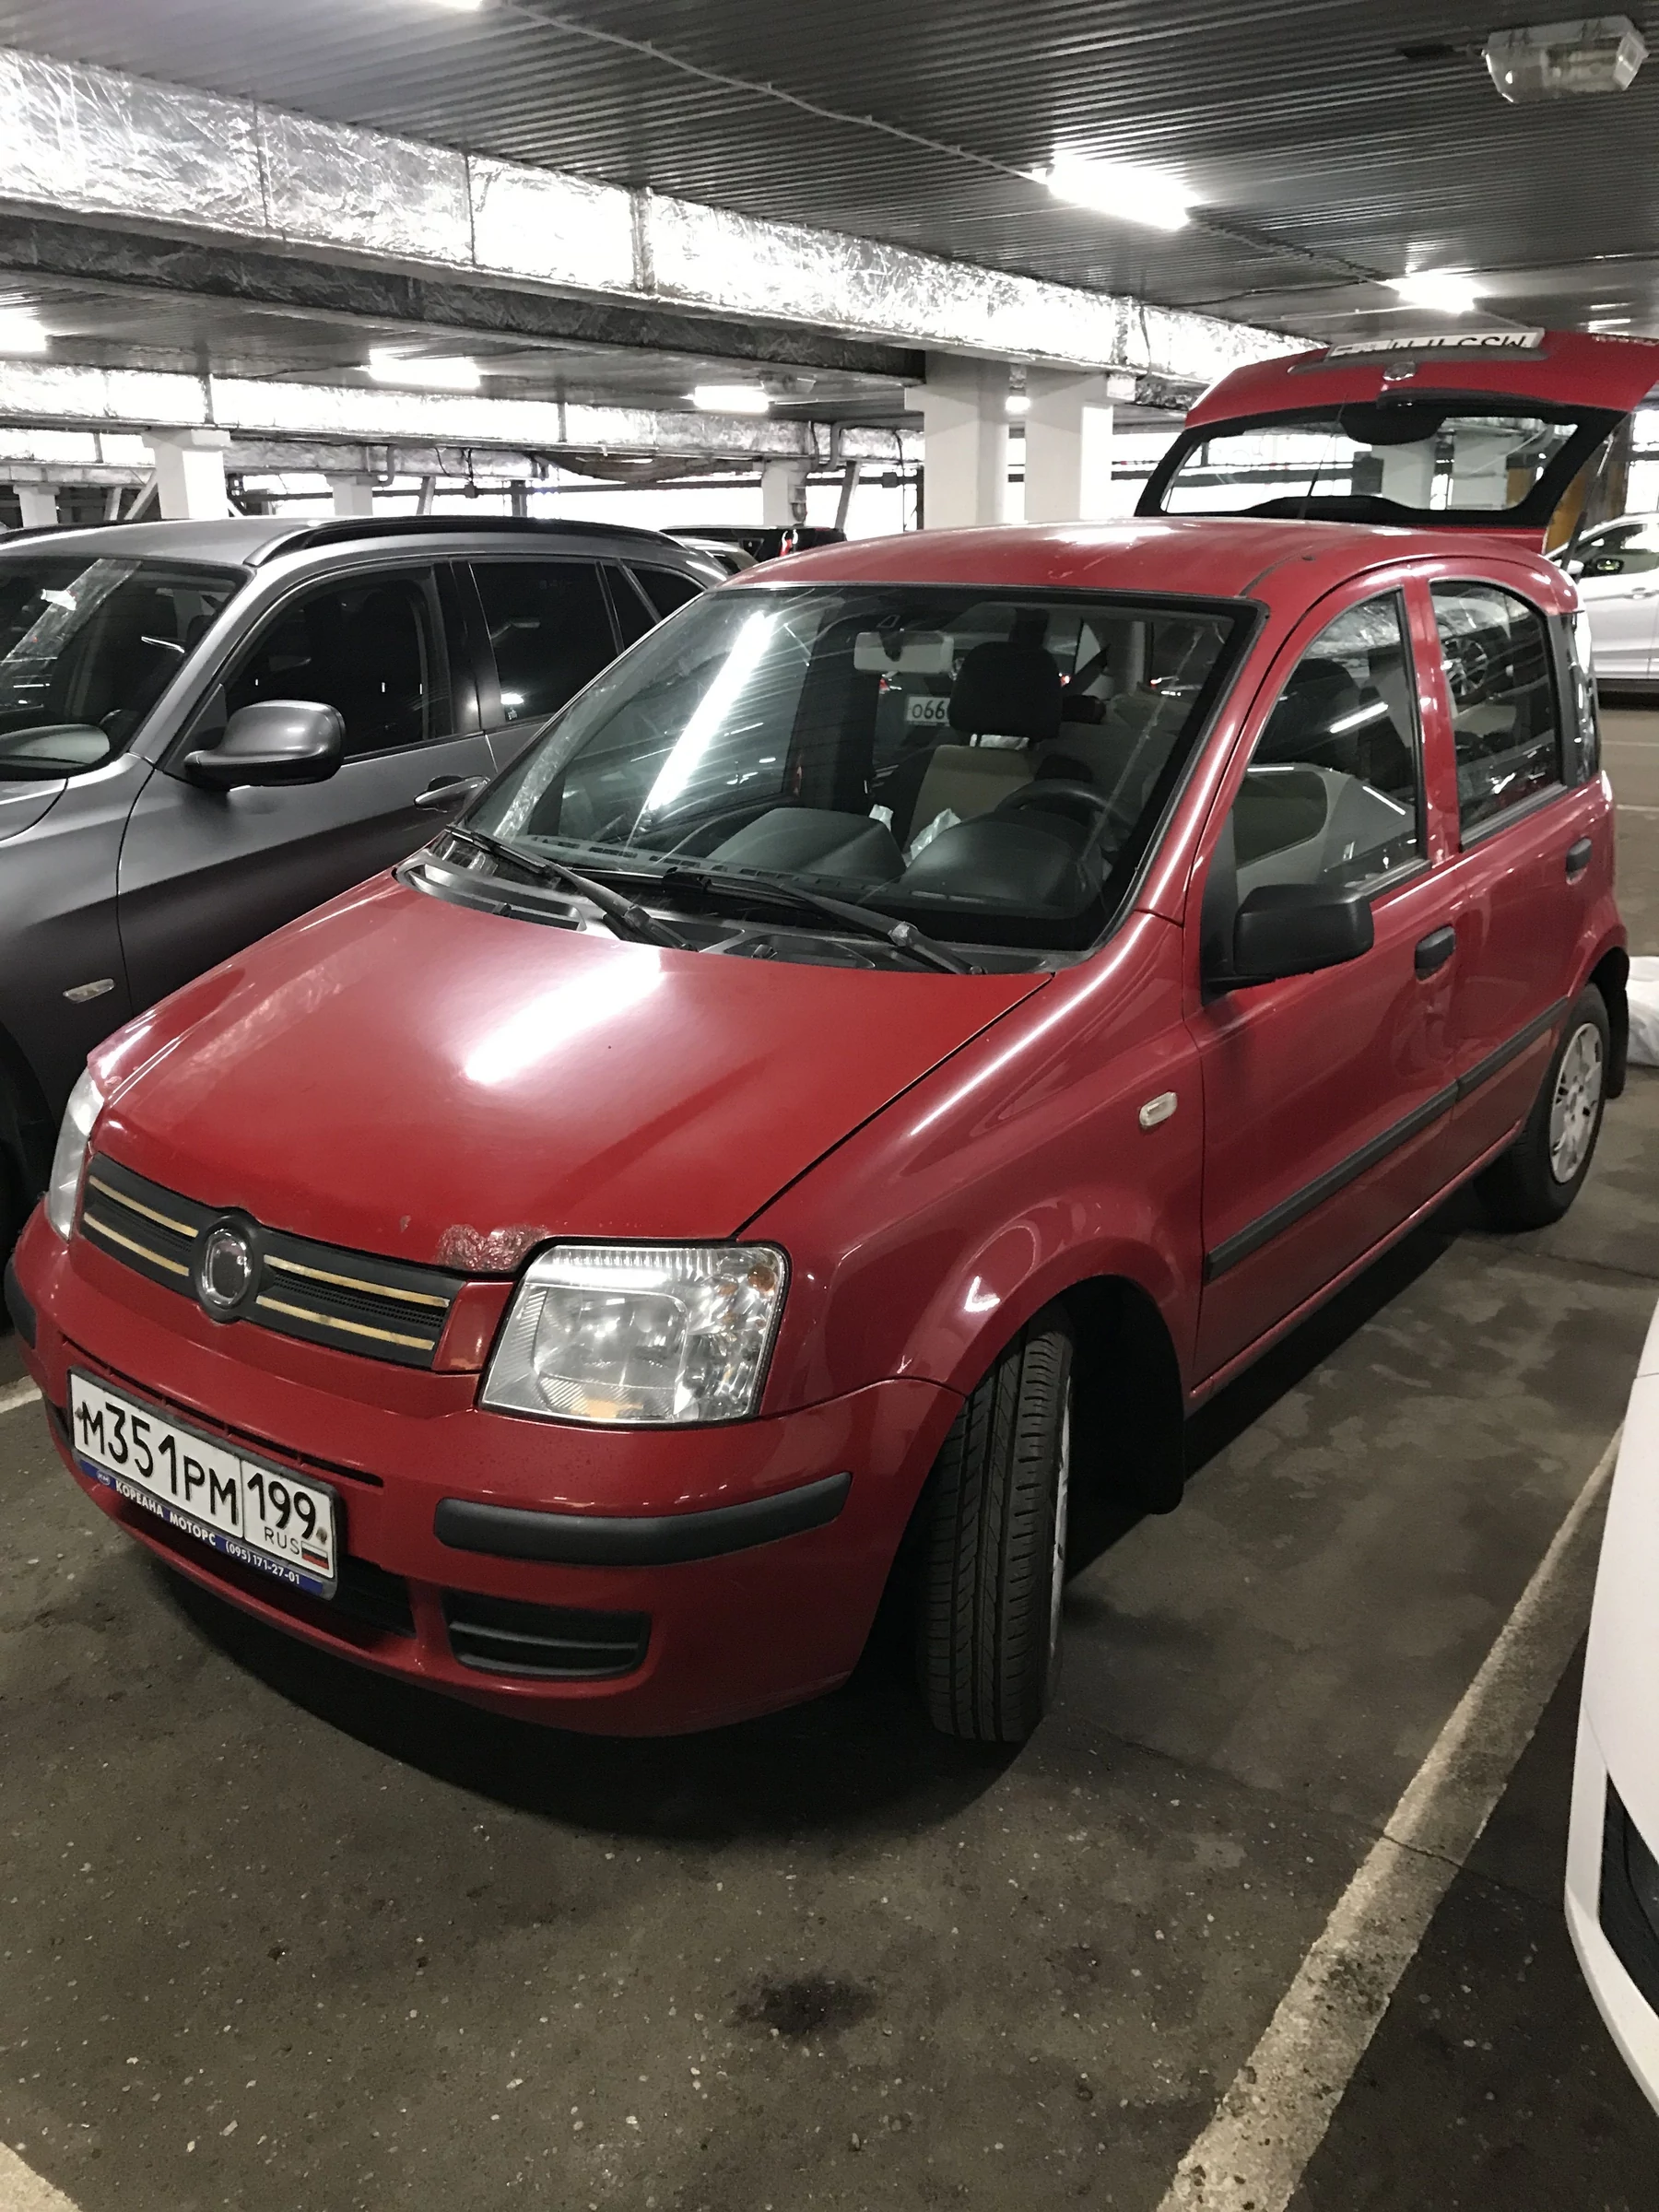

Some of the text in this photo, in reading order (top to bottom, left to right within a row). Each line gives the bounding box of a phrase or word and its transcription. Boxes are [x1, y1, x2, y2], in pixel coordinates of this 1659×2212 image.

[114, 1480, 164, 1518] КОРЕАНА
[170, 1512, 218, 1547] МОТОРС
[225, 1540, 252, 1563] (095)
[247, 1472, 317, 1540] 199
[264, 1525, 300, 1556] RUS
